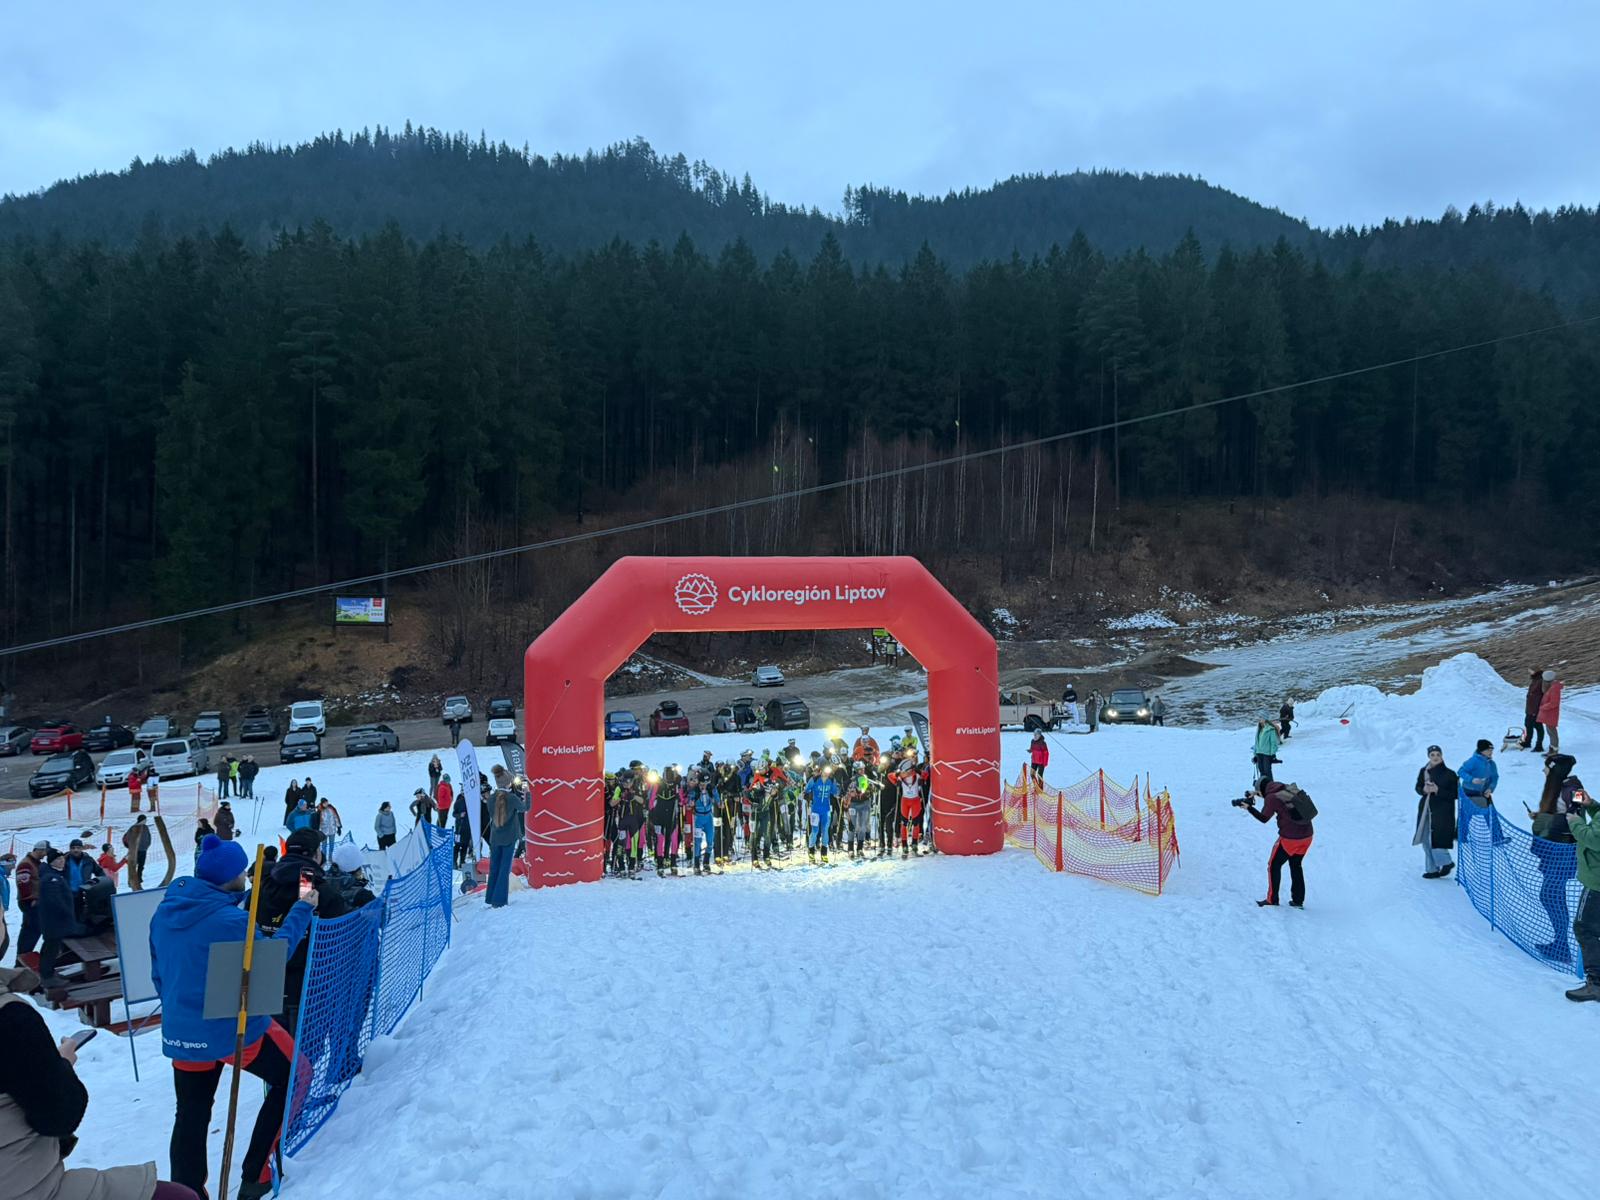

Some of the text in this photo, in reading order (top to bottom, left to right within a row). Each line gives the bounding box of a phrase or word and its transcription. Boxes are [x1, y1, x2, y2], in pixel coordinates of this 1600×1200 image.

[728, 585, 886, 605] Cykloregión Liptov
[955, 726, 996, 736] #VisitLiptov
[542, 745, 596, 756] #CykloLiptov
